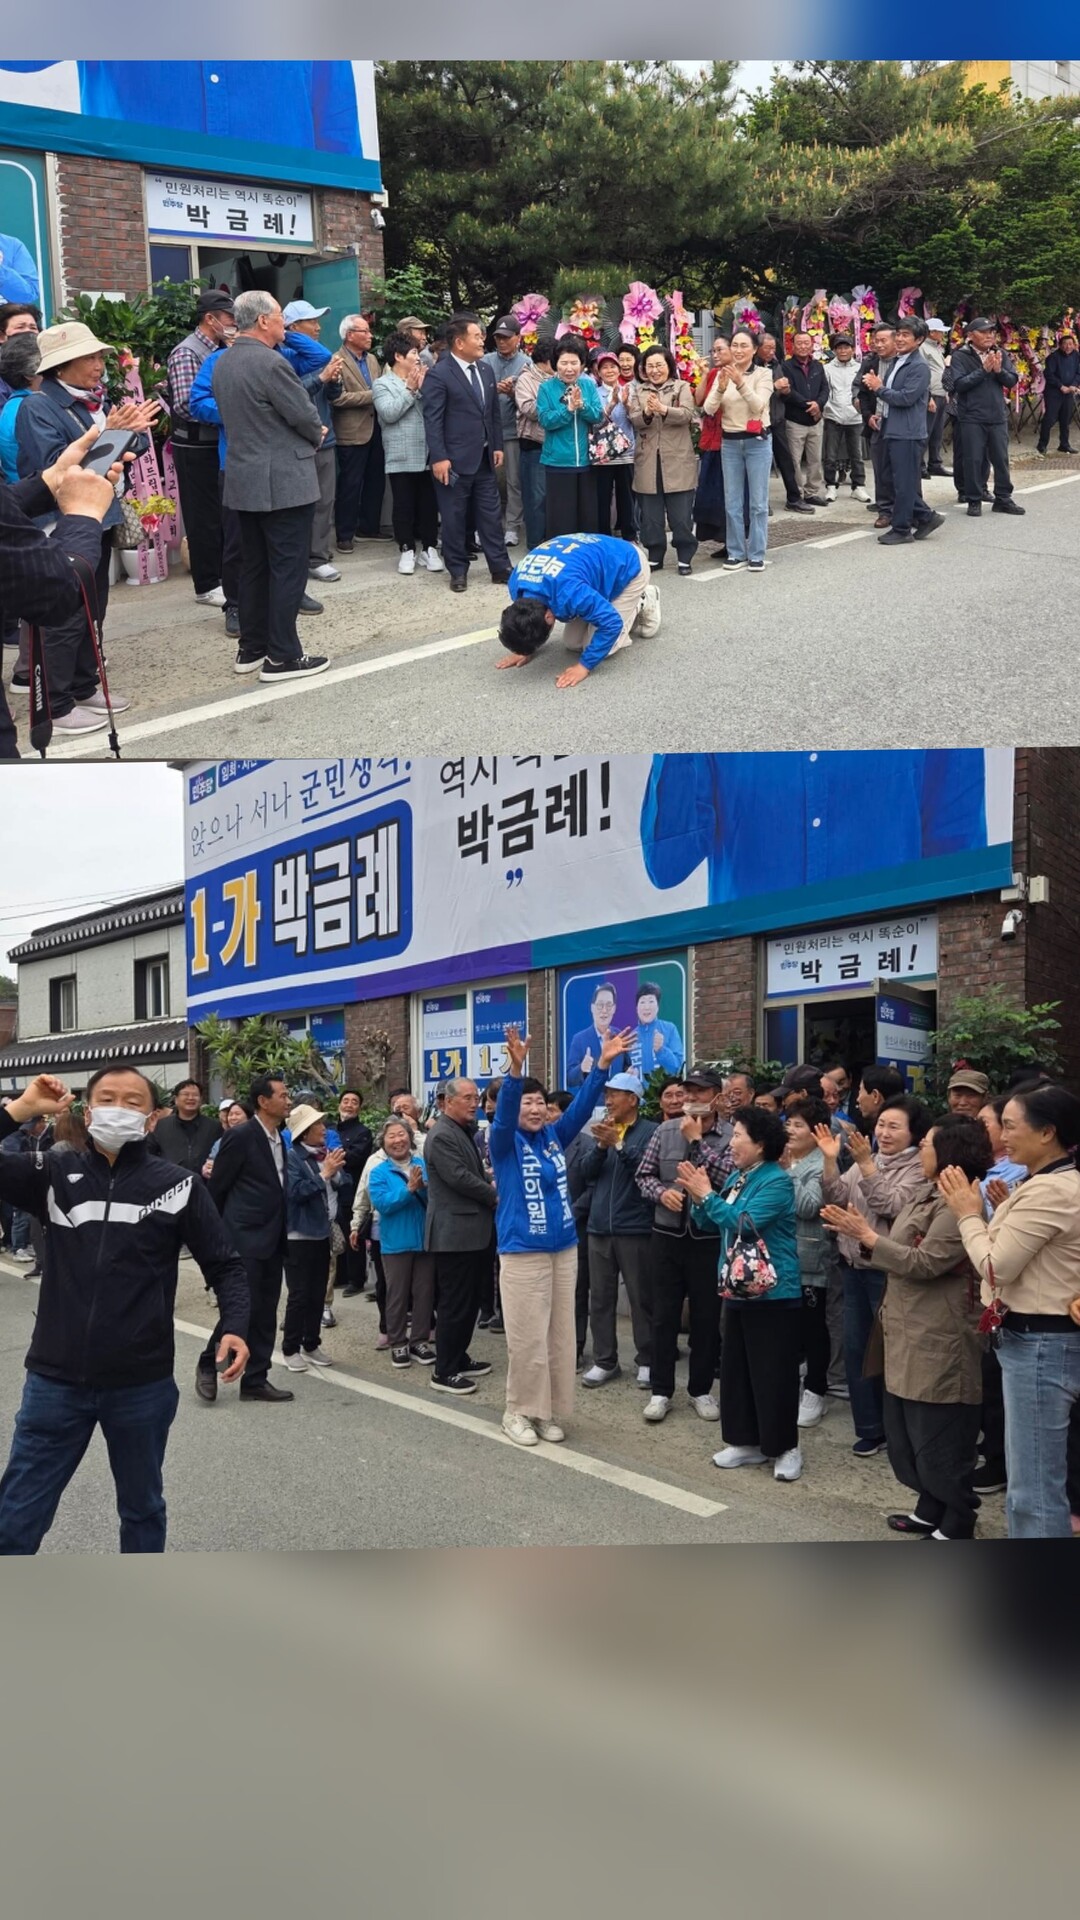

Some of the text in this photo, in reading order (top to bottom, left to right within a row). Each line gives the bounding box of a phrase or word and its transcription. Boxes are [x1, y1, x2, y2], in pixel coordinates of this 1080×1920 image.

[235, 189, 258, 203] 역시
[186, 204, 210, 229] 박
[226, 208, 249, 232] 금
[34, 664, 43, 712] Canon
[192, 777, 214, 801] 민주당
[439, 756, 498, 799] 역시
[191, 803, 243, 857] 앉으나
[250, 781, 292, 829] 서나
[457, 760, 611, 866] 박금례!
[190, 820, 400, 976] 1-가 박금례
[848, 929, 874, 945] 역시
[801, 959, 823, 983] 박
[838, 953, 861, 980] 금
[430, 1049, 462, 1079] 1-가
[521, 1155, 547, 1224] 군의원
[529, 1224, 548, 1235] 후보
